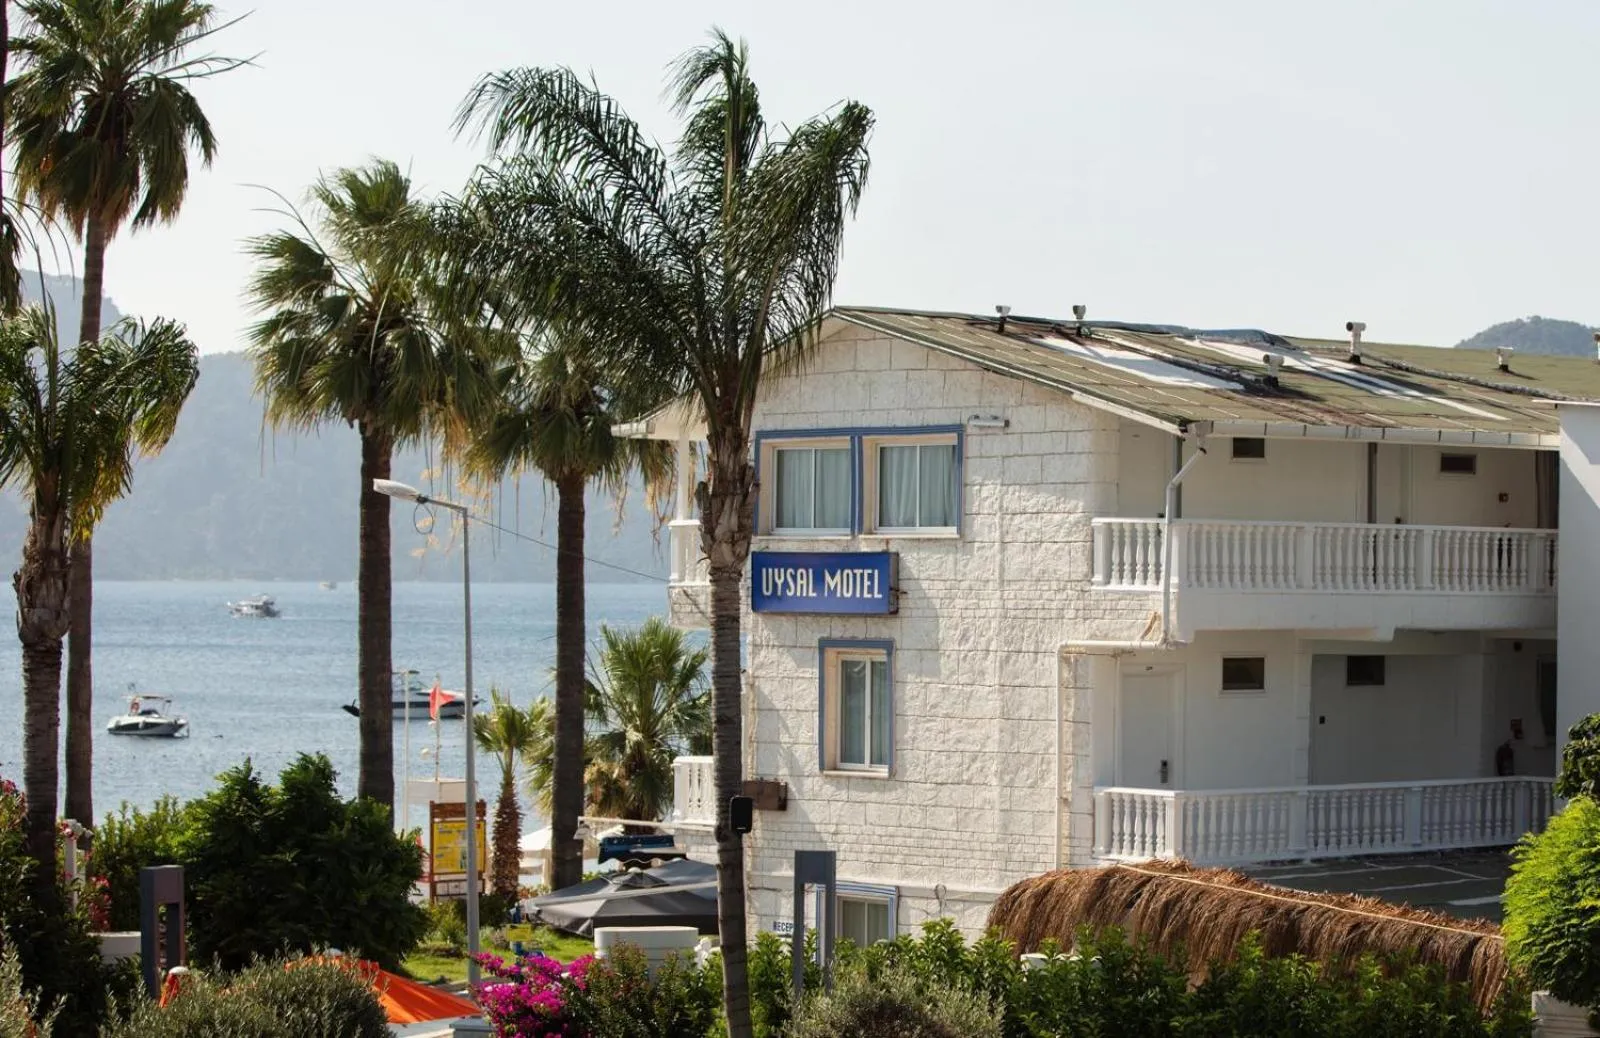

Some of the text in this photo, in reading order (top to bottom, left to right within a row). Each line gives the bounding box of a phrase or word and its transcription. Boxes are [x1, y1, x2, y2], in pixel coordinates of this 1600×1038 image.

[761, 567, 883, 599] UYSAL MOTEL
[773, 921, 794, 932] RECEP
